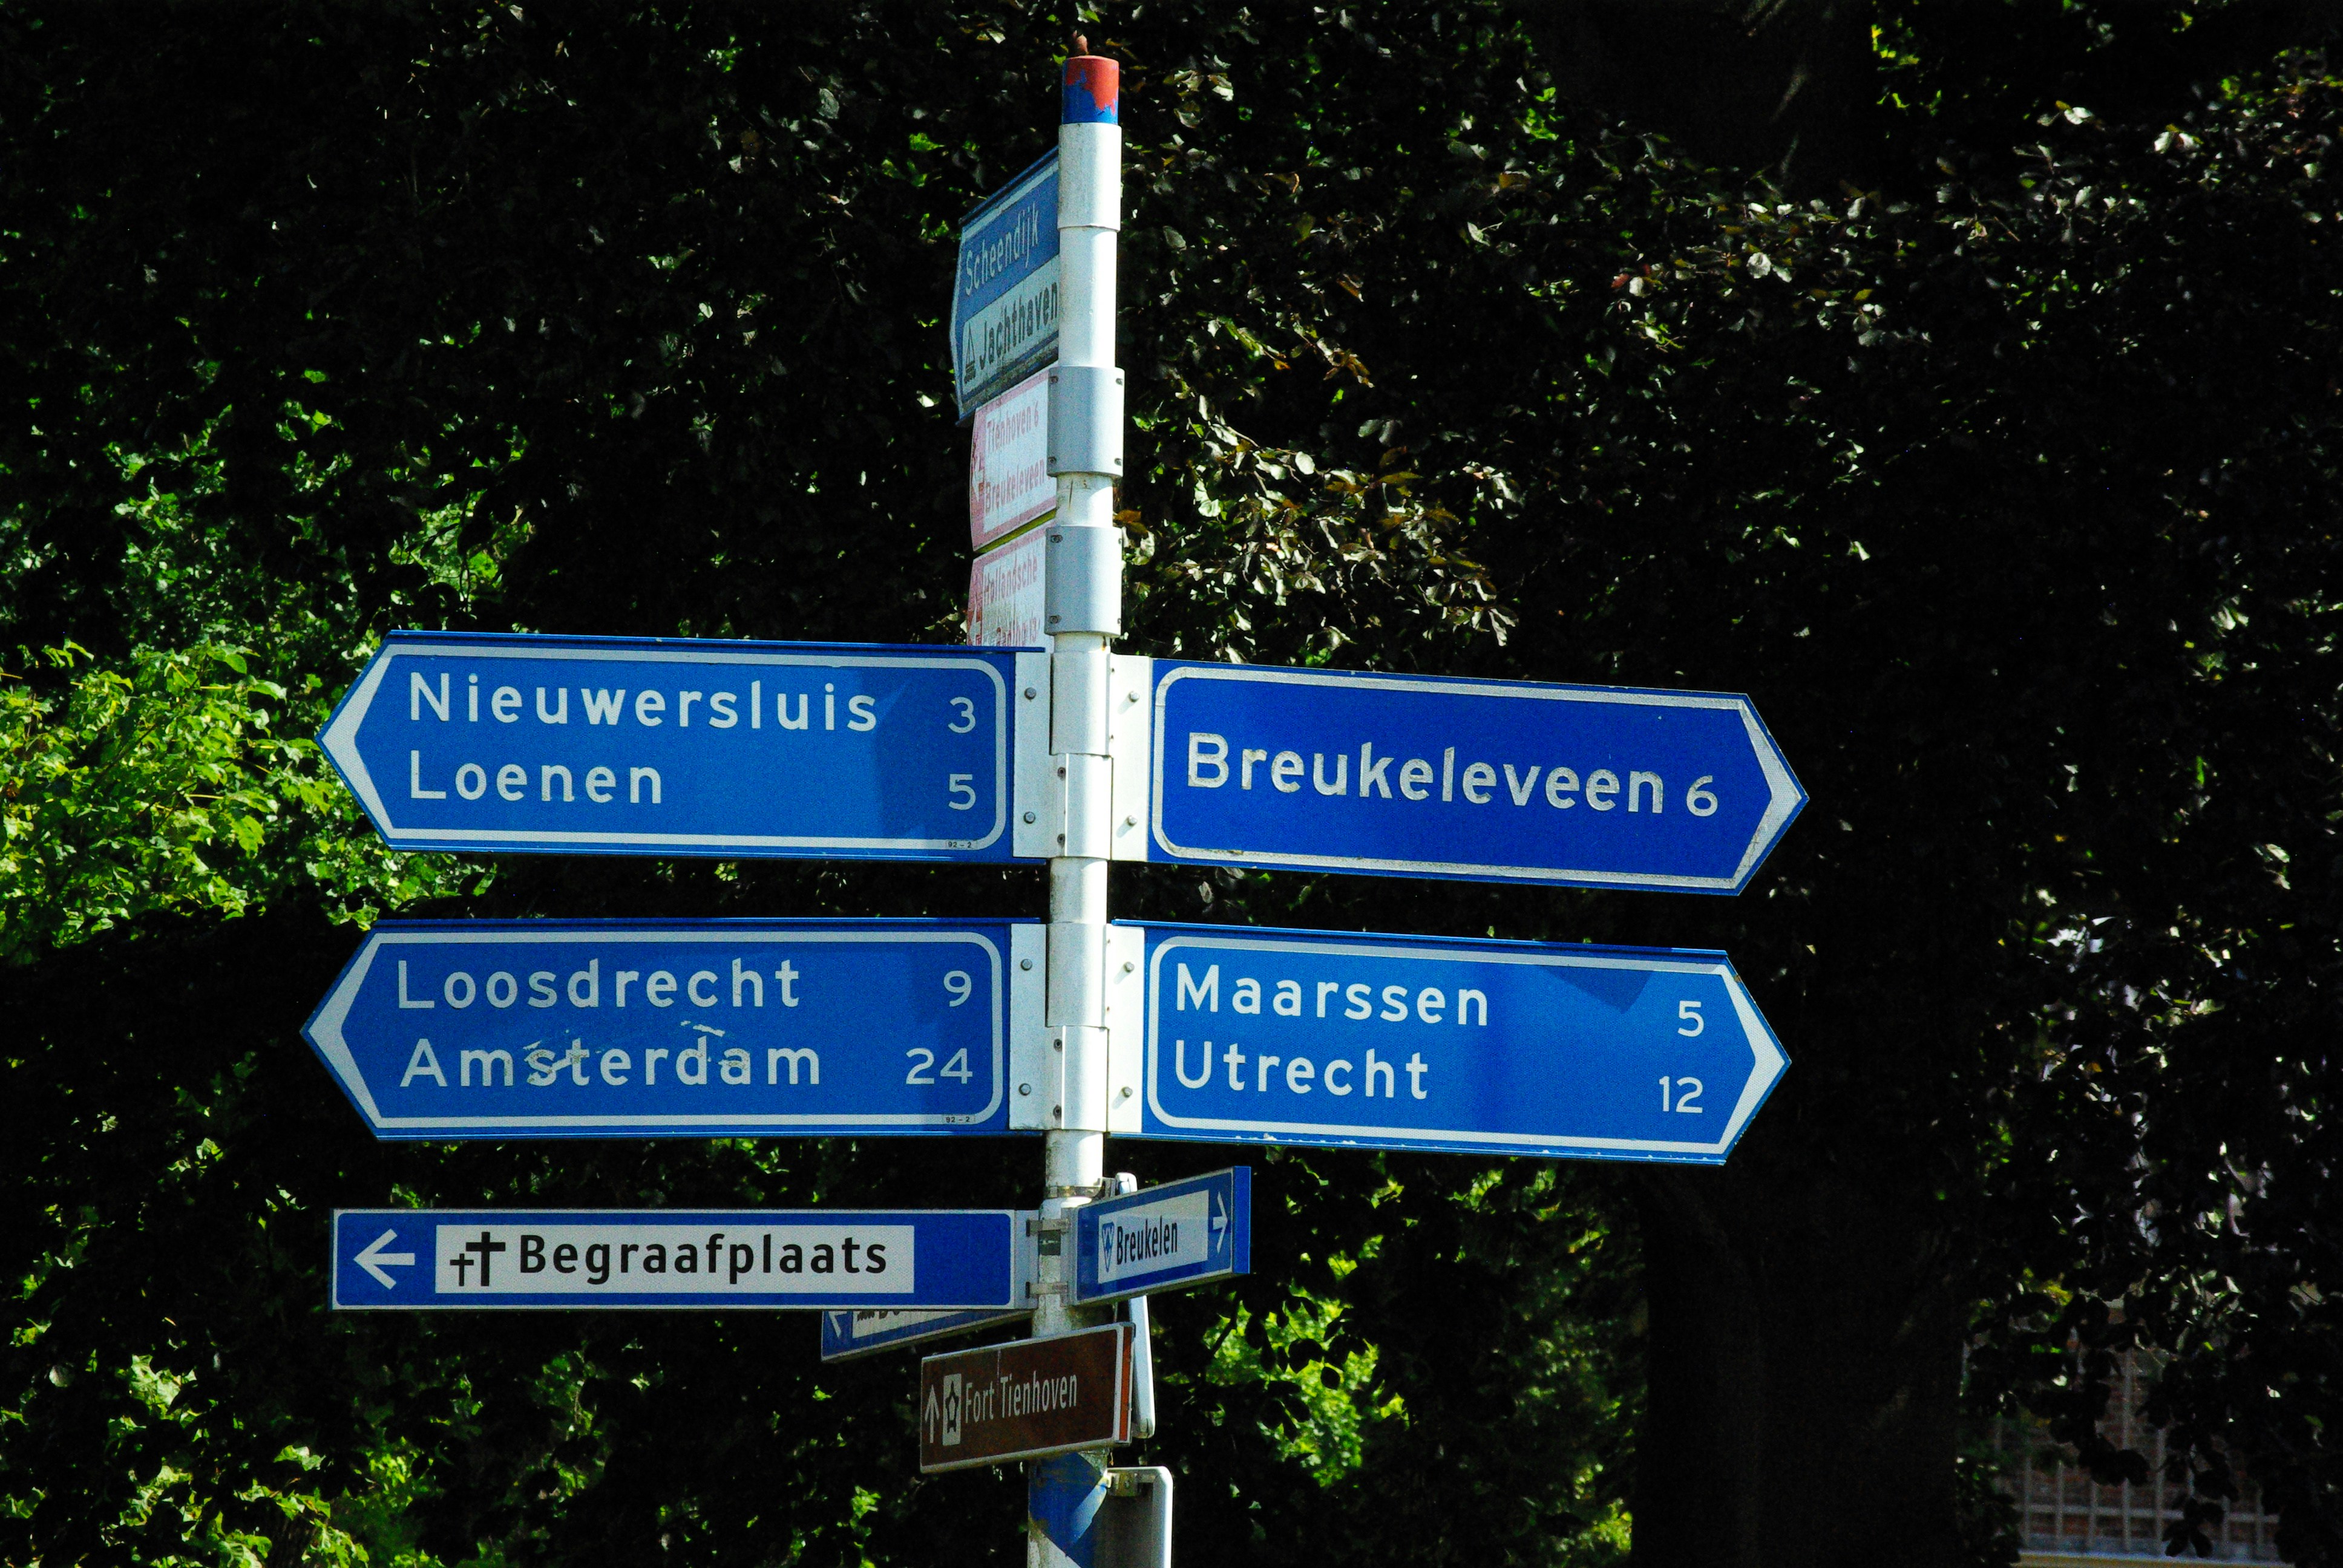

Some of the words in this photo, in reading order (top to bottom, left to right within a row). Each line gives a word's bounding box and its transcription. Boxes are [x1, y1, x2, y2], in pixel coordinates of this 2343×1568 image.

[965, 201, 1040, 296] Scheendijk
[978, 281, 1058, 371] Jachthaven
[987, 405, 1032, 453] Tienhoven
[985, 458, 1045, 513] Breukeleveen
[983, 552, 1038, 607] Hollandsche
[410, 671, 877, 731] Nieuwersluis
[948, 696, 976, 733] 3
[410, 750, 661, 804] Loenen
[948, 774, 976, 811] 5
[1187, 732, 1663, 814] Breukeleveen
[1686, 776, 1719, 817] 6
[399, 958, 799, 1008] Loosdrecht
[943, 970, 972, 1007] 9
[1176, 964, 1488, 1026] Maarssen
[1678, 1000, 1704, 1037] 5
[401, 1036, 819, 1087] Amsterdam
[906, 1048, 972, 1085] 24
[1175, 1039, 1428, 1100] Utrecht
[1659, 1076, 1703, 1113] 12
[520, 1233, 886, 1285] Begraafplaats
[1116, 1217, 1178, 1266] Breukelen
[965, 1382, 995, 1423] Fort
[1000, 1370, 1078, 1417] Tienhoven
